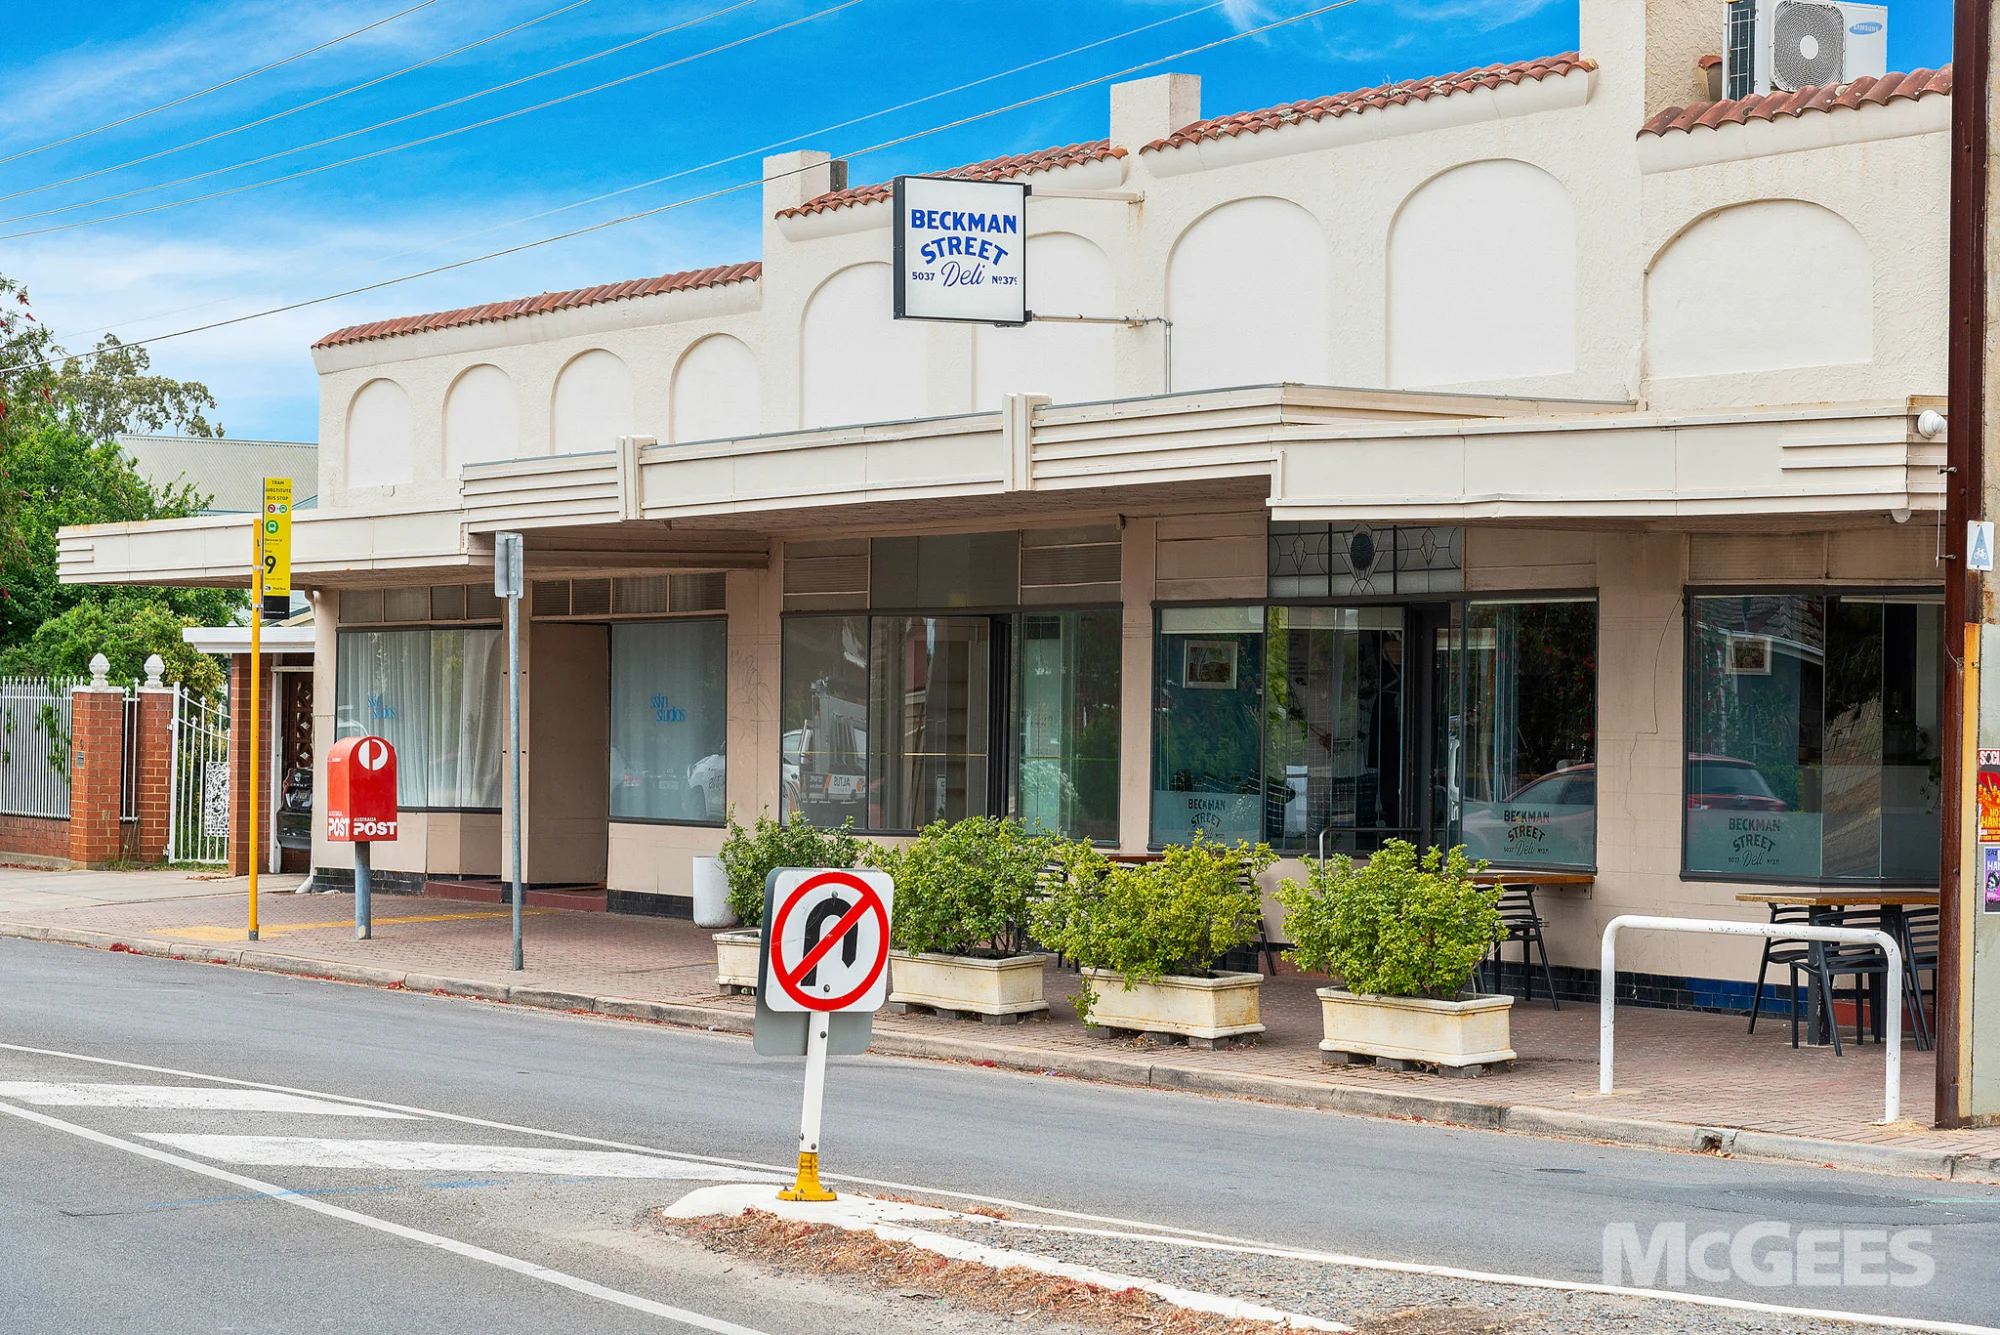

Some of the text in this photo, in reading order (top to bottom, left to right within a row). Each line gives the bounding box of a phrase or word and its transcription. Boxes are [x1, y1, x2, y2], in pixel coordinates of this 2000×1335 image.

[1853, 22, 1879, 32] SAMSUNG
[911, 209, 1017, 234] BECKMAN
[920, 236, 1009, 266] STREET
[912, 271, 935, 281] 5037
[940, 261, 985, 287] Deli
[265, 556, 276, 574] 9
[1188, 799, 1225, 811] BECKMAN
[1989, 808, 1999, 816] NO
[1190, 812, 1222, 828] STREET
[1504, 810, 1549, 823] BECKMAN
[1981, 815, 2000, 827] HAN
[328, 818, 350, 837] POST
[353, 822, 397, 836] POST
[1729, 818, 1780, 832] BECKMAN
[1507, 825, 1546, 842] STREET
[1516, 840, 1535, 856] Deli
[1732, 834, 1776, 852] STREET
[1742, 850, 1764, 867] Deli
